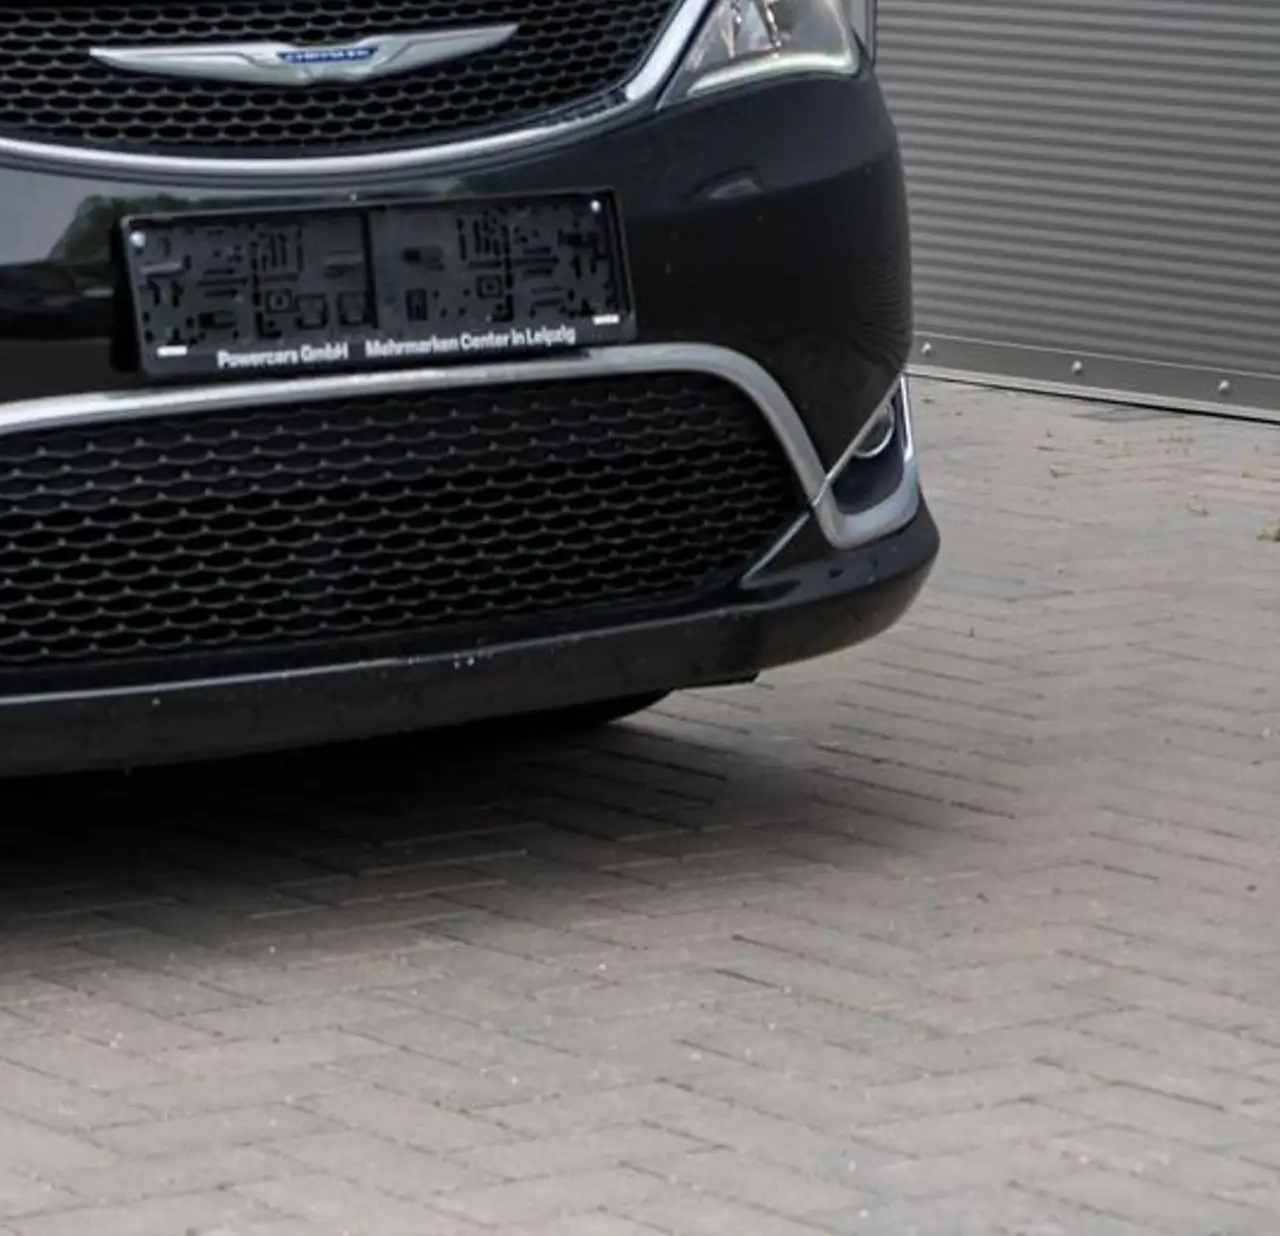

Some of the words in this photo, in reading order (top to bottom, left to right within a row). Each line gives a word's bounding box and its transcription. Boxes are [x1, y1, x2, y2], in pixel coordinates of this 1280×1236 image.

[300, 341, 349, 363] GmbH
[460, 330, 509, 351] Center
[525, 324, 576, 347] Leipzig
